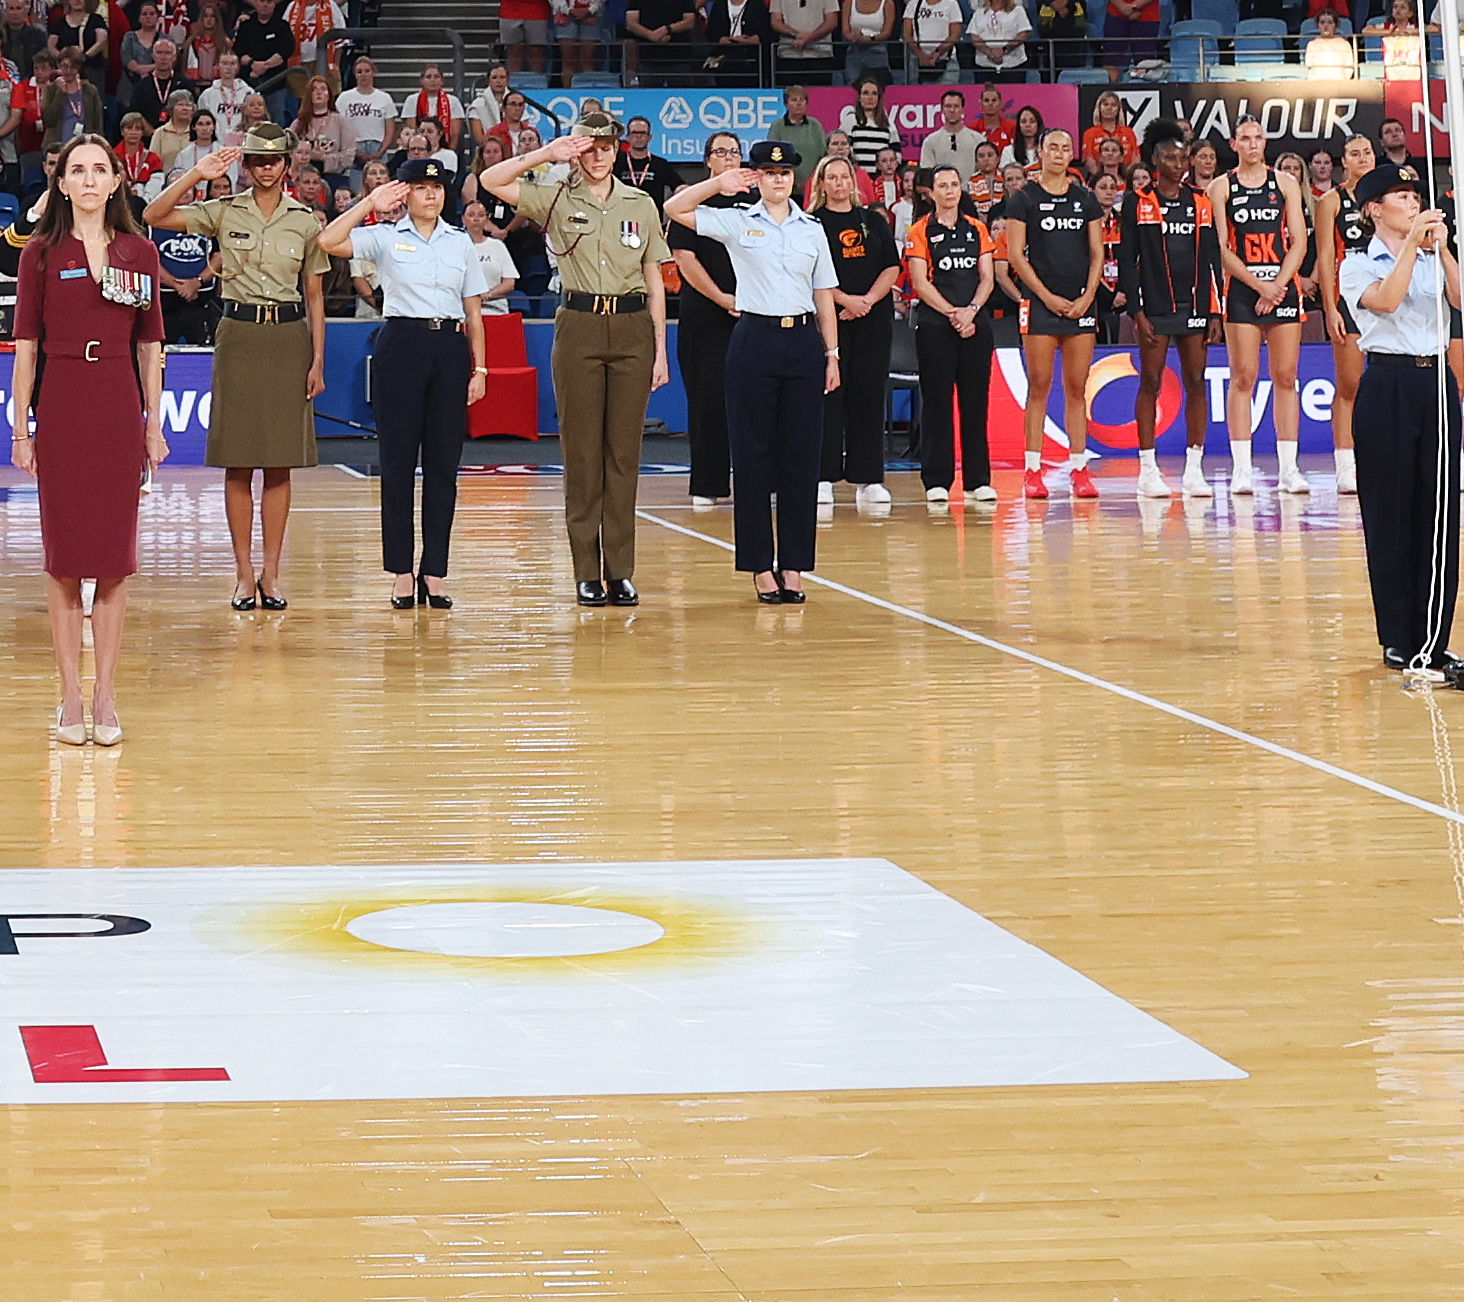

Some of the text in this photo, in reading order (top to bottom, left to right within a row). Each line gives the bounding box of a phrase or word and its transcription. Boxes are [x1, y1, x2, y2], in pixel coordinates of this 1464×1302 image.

[698, 95, 781, 130] QBE
[1250, 208, 1280, 221] HCF
[1057, 218, 1085, 231] HCF
[1169, 222, 1196, 235] HCF
[169, 233, 208, 254] FOX
[1243, 233, 1281, 264] GK
[954, 256, 978, 269] HCF
